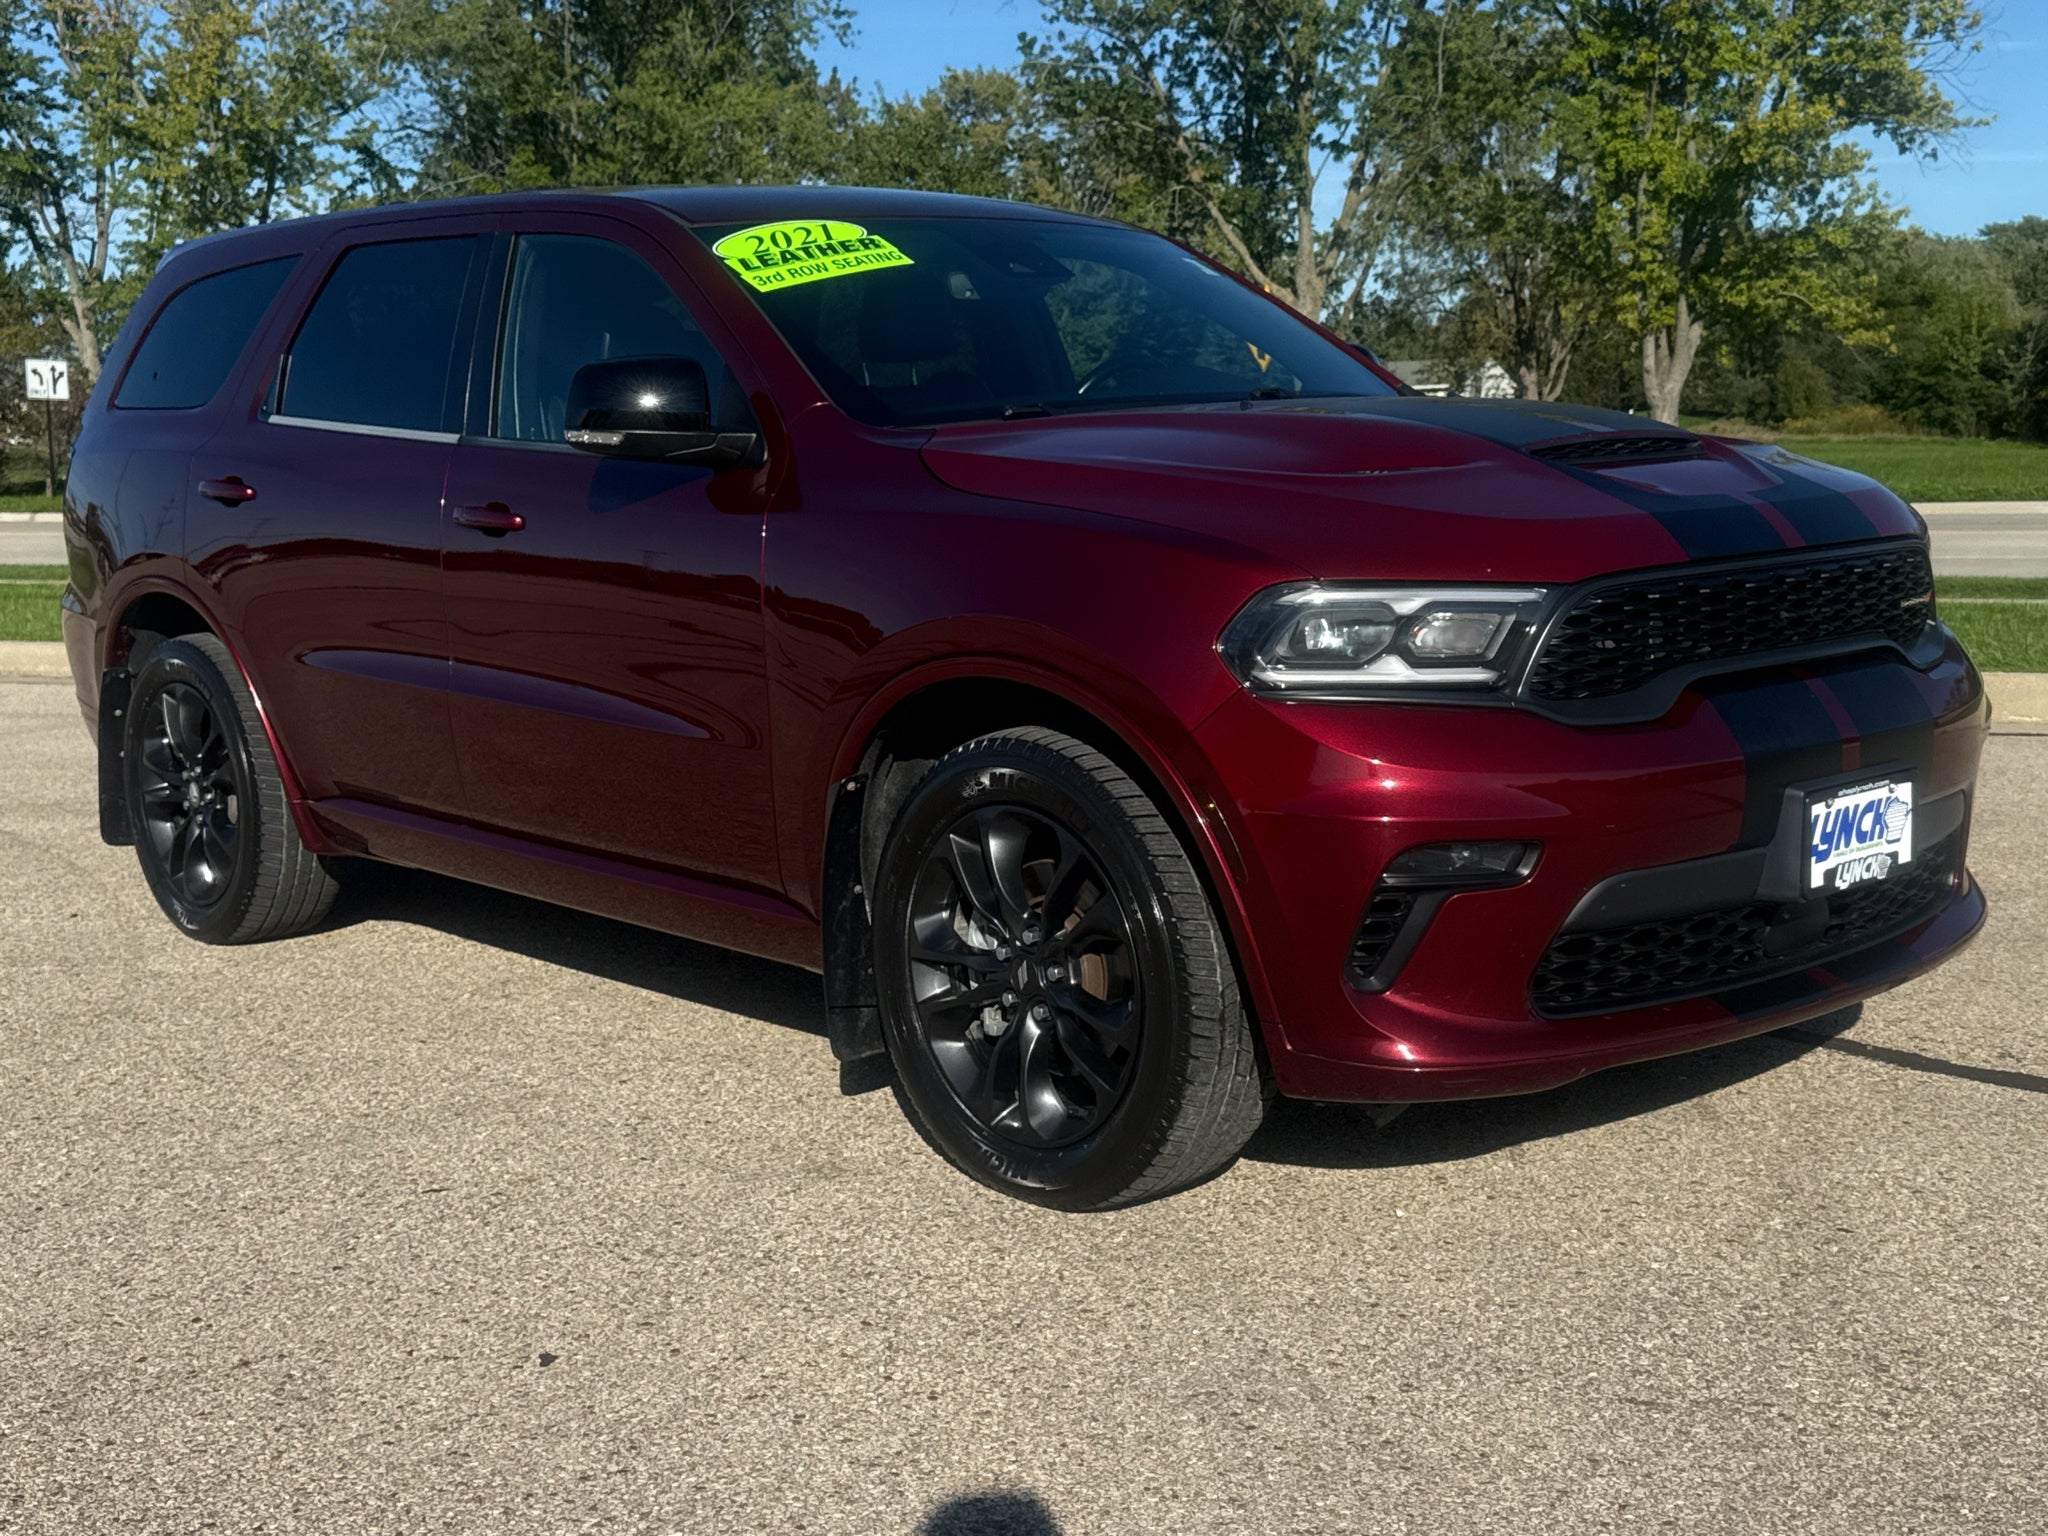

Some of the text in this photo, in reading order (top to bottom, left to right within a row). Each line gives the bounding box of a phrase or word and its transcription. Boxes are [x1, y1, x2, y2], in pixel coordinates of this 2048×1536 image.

[737, 237, 887, 272] LEATHER
[744, 223, 835, 255] 2021
[753, 250, 904, 287] 3rd ROW SEATING
[1811, 796, 1891, 864] LYNCH
[1835, 855, 1880, 890] LYNCH
